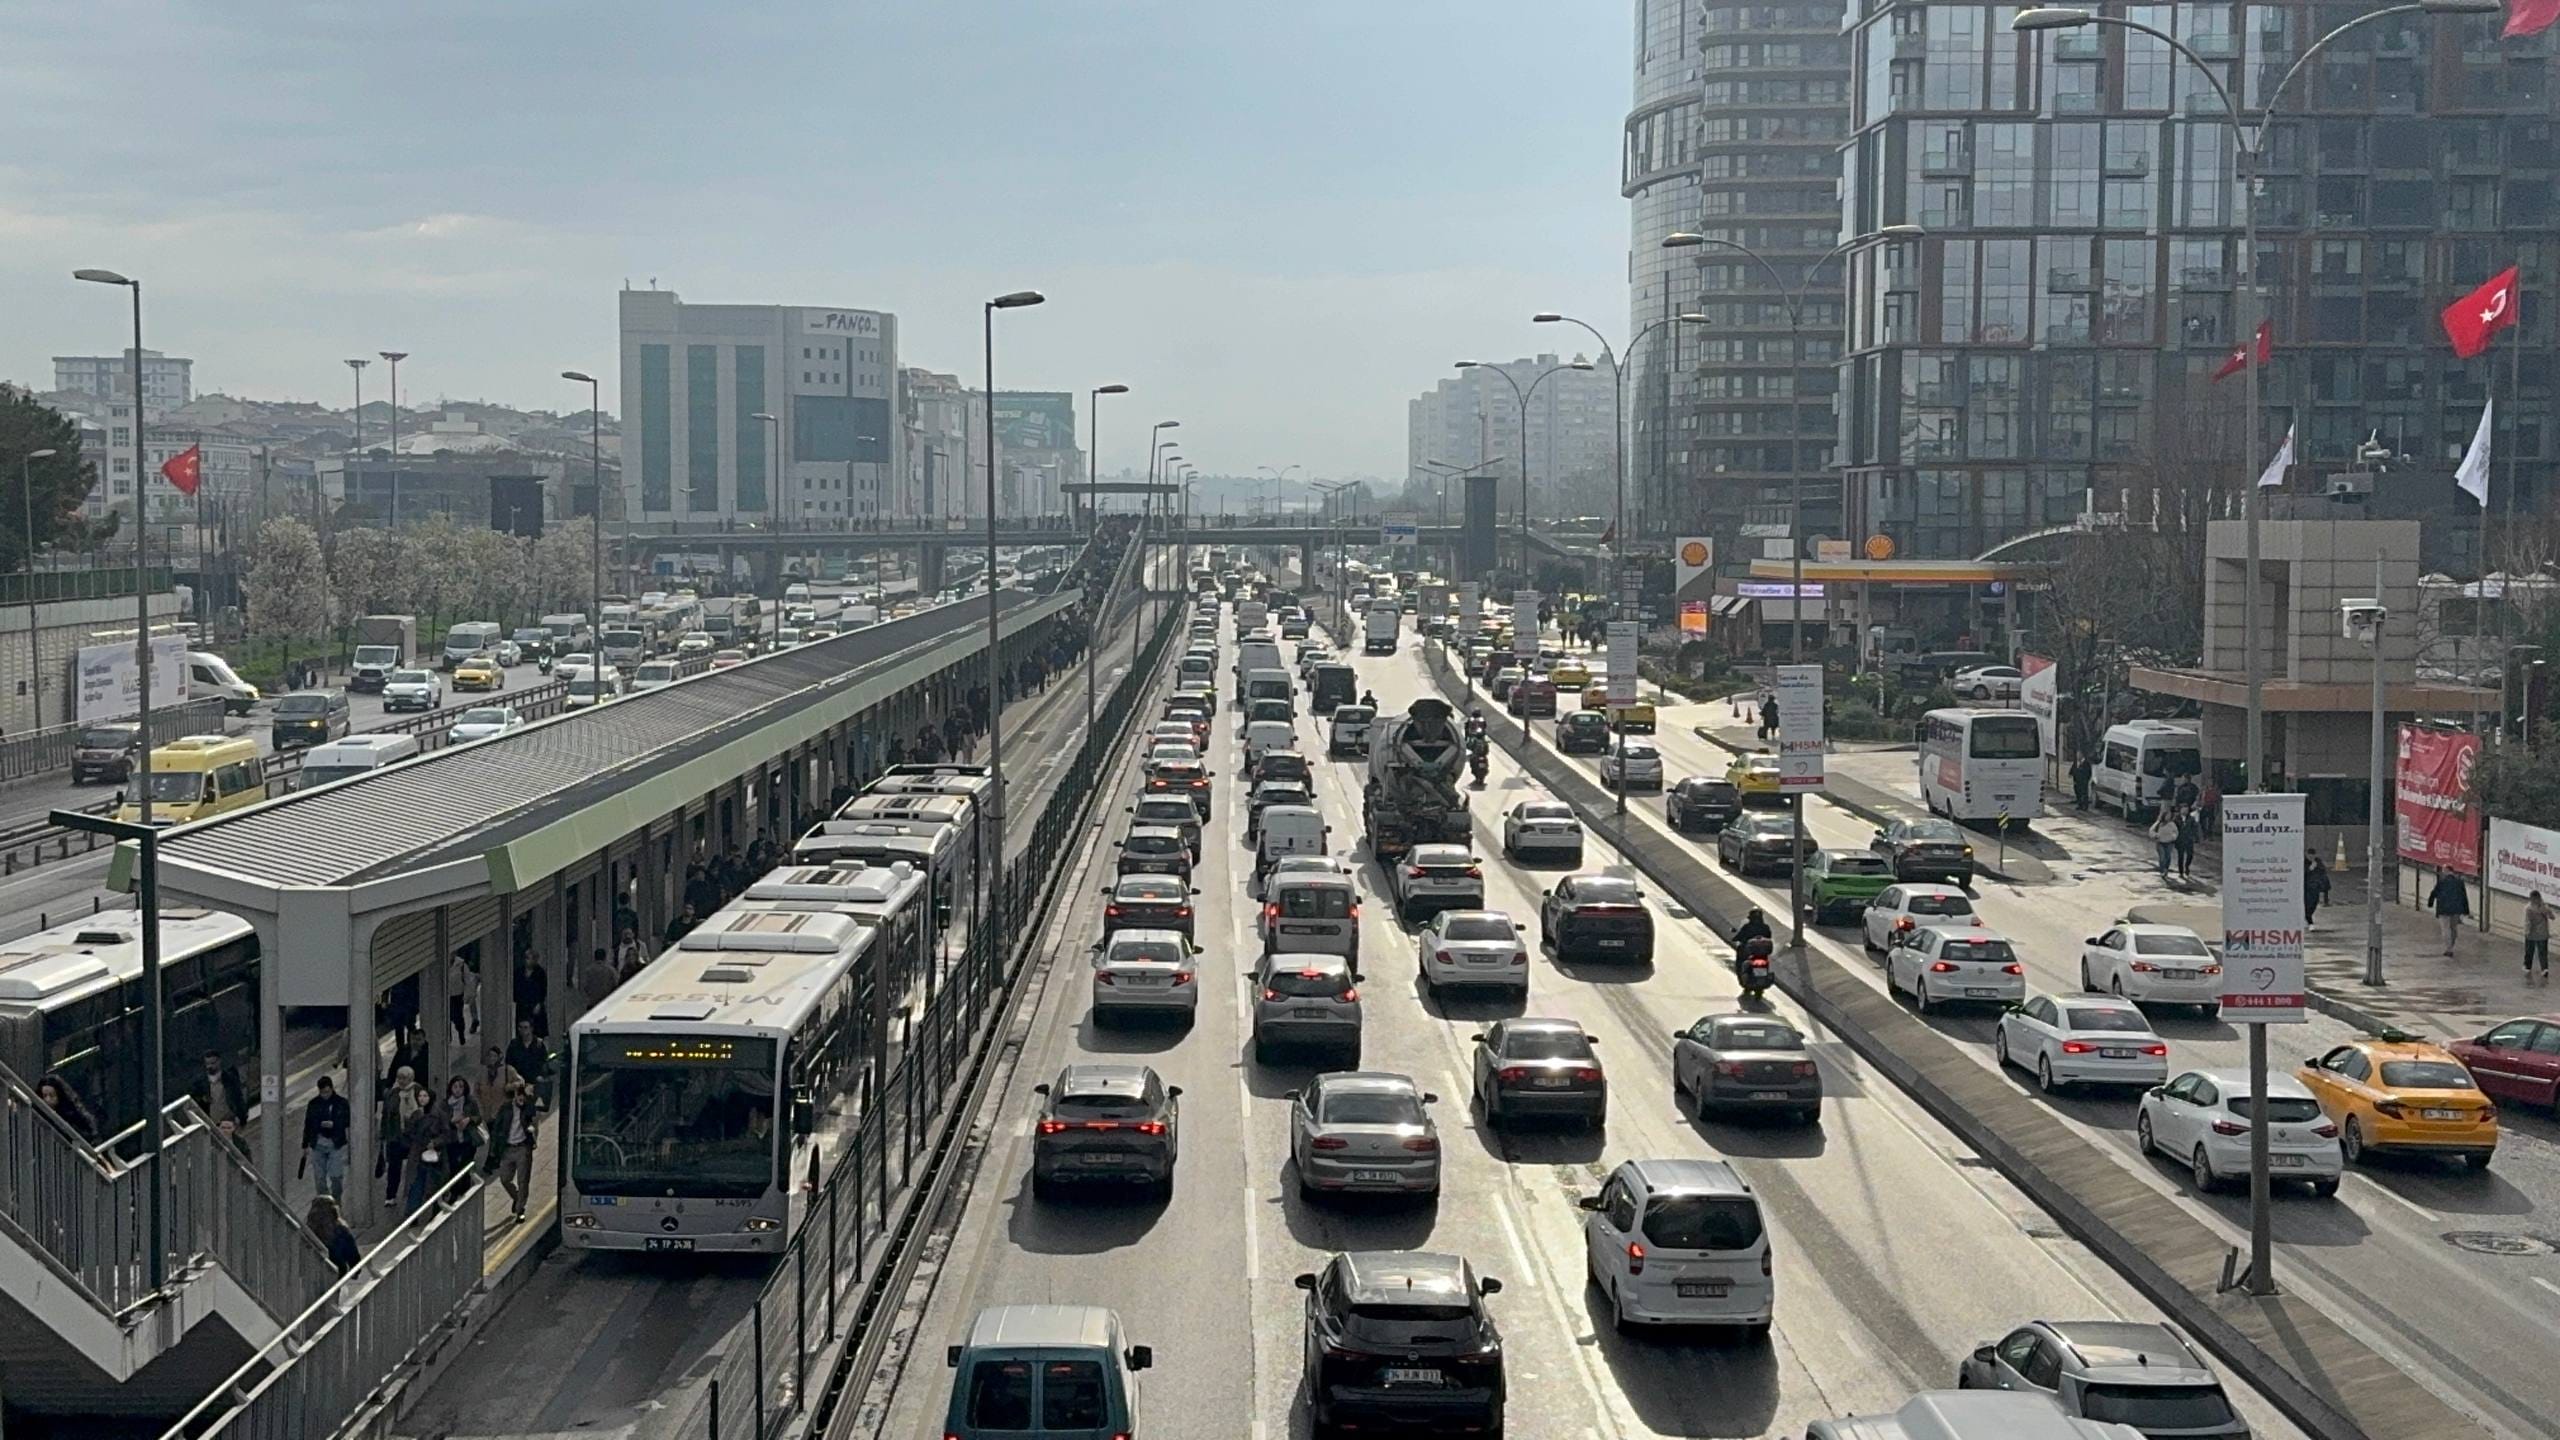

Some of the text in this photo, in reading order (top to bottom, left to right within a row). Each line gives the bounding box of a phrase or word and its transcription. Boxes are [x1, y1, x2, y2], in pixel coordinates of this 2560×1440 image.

[826, 313, 872, 334] PANÇO
[2224, 809, 2279, 820] Yarın da
[2250, 929, 2303, 945] HSM
